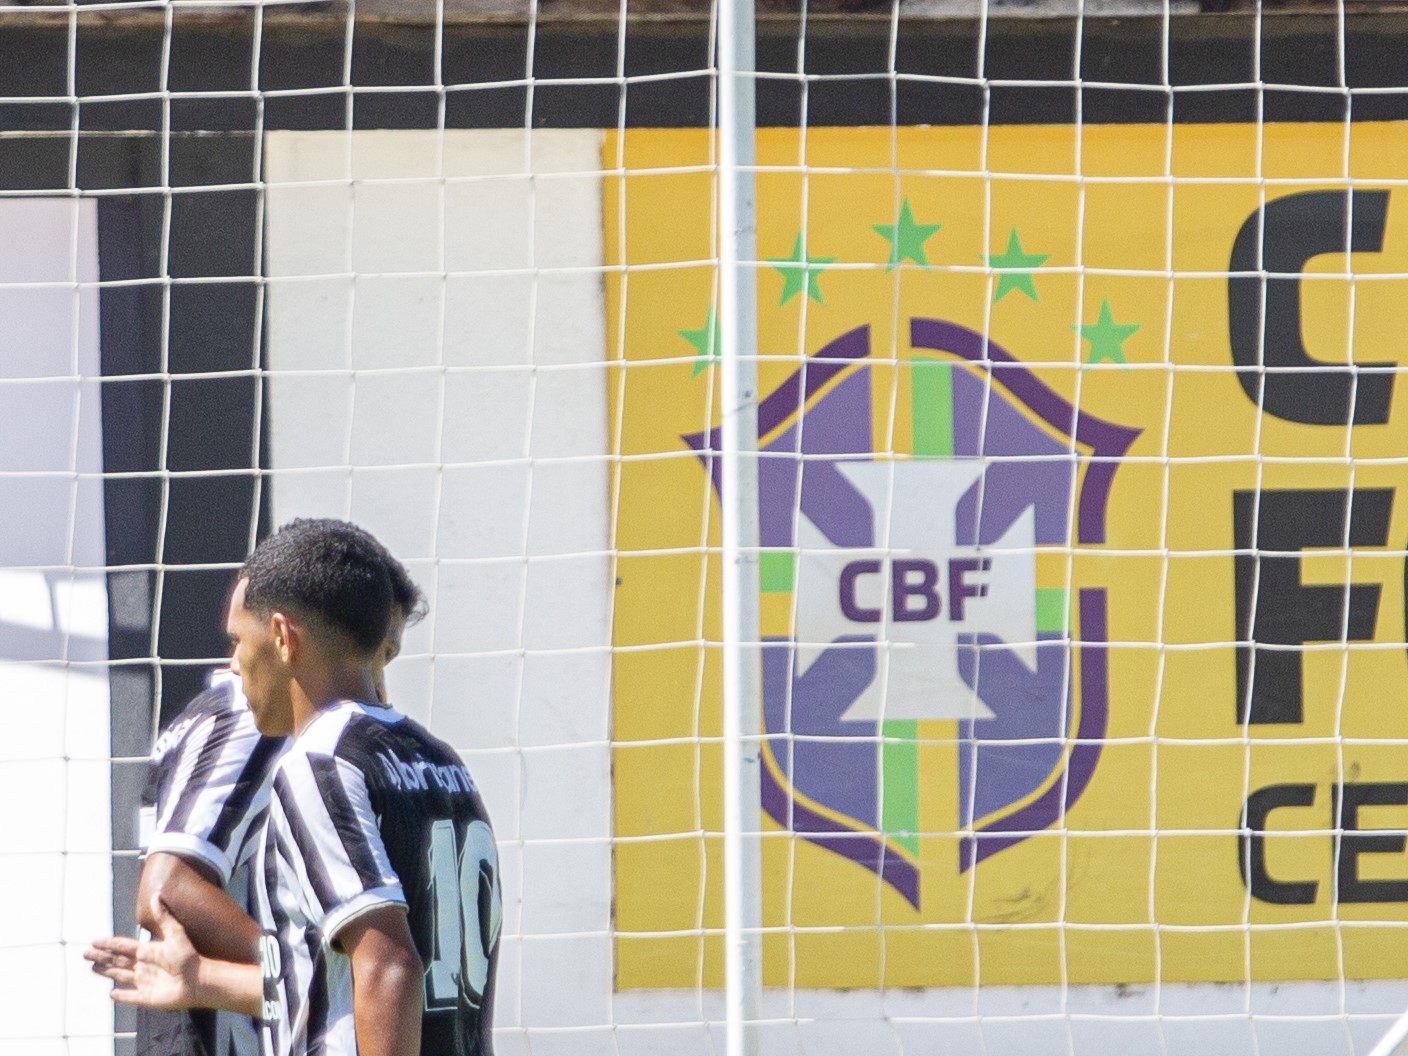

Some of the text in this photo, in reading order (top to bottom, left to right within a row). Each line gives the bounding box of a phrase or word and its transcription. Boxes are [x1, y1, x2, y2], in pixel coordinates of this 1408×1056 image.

[840, 557, 992, 623] CBF
[1233, 487, 1408, 725] F
[426, 819, 503, 1010] 10
[1238, 782, 1408, 905] CE
